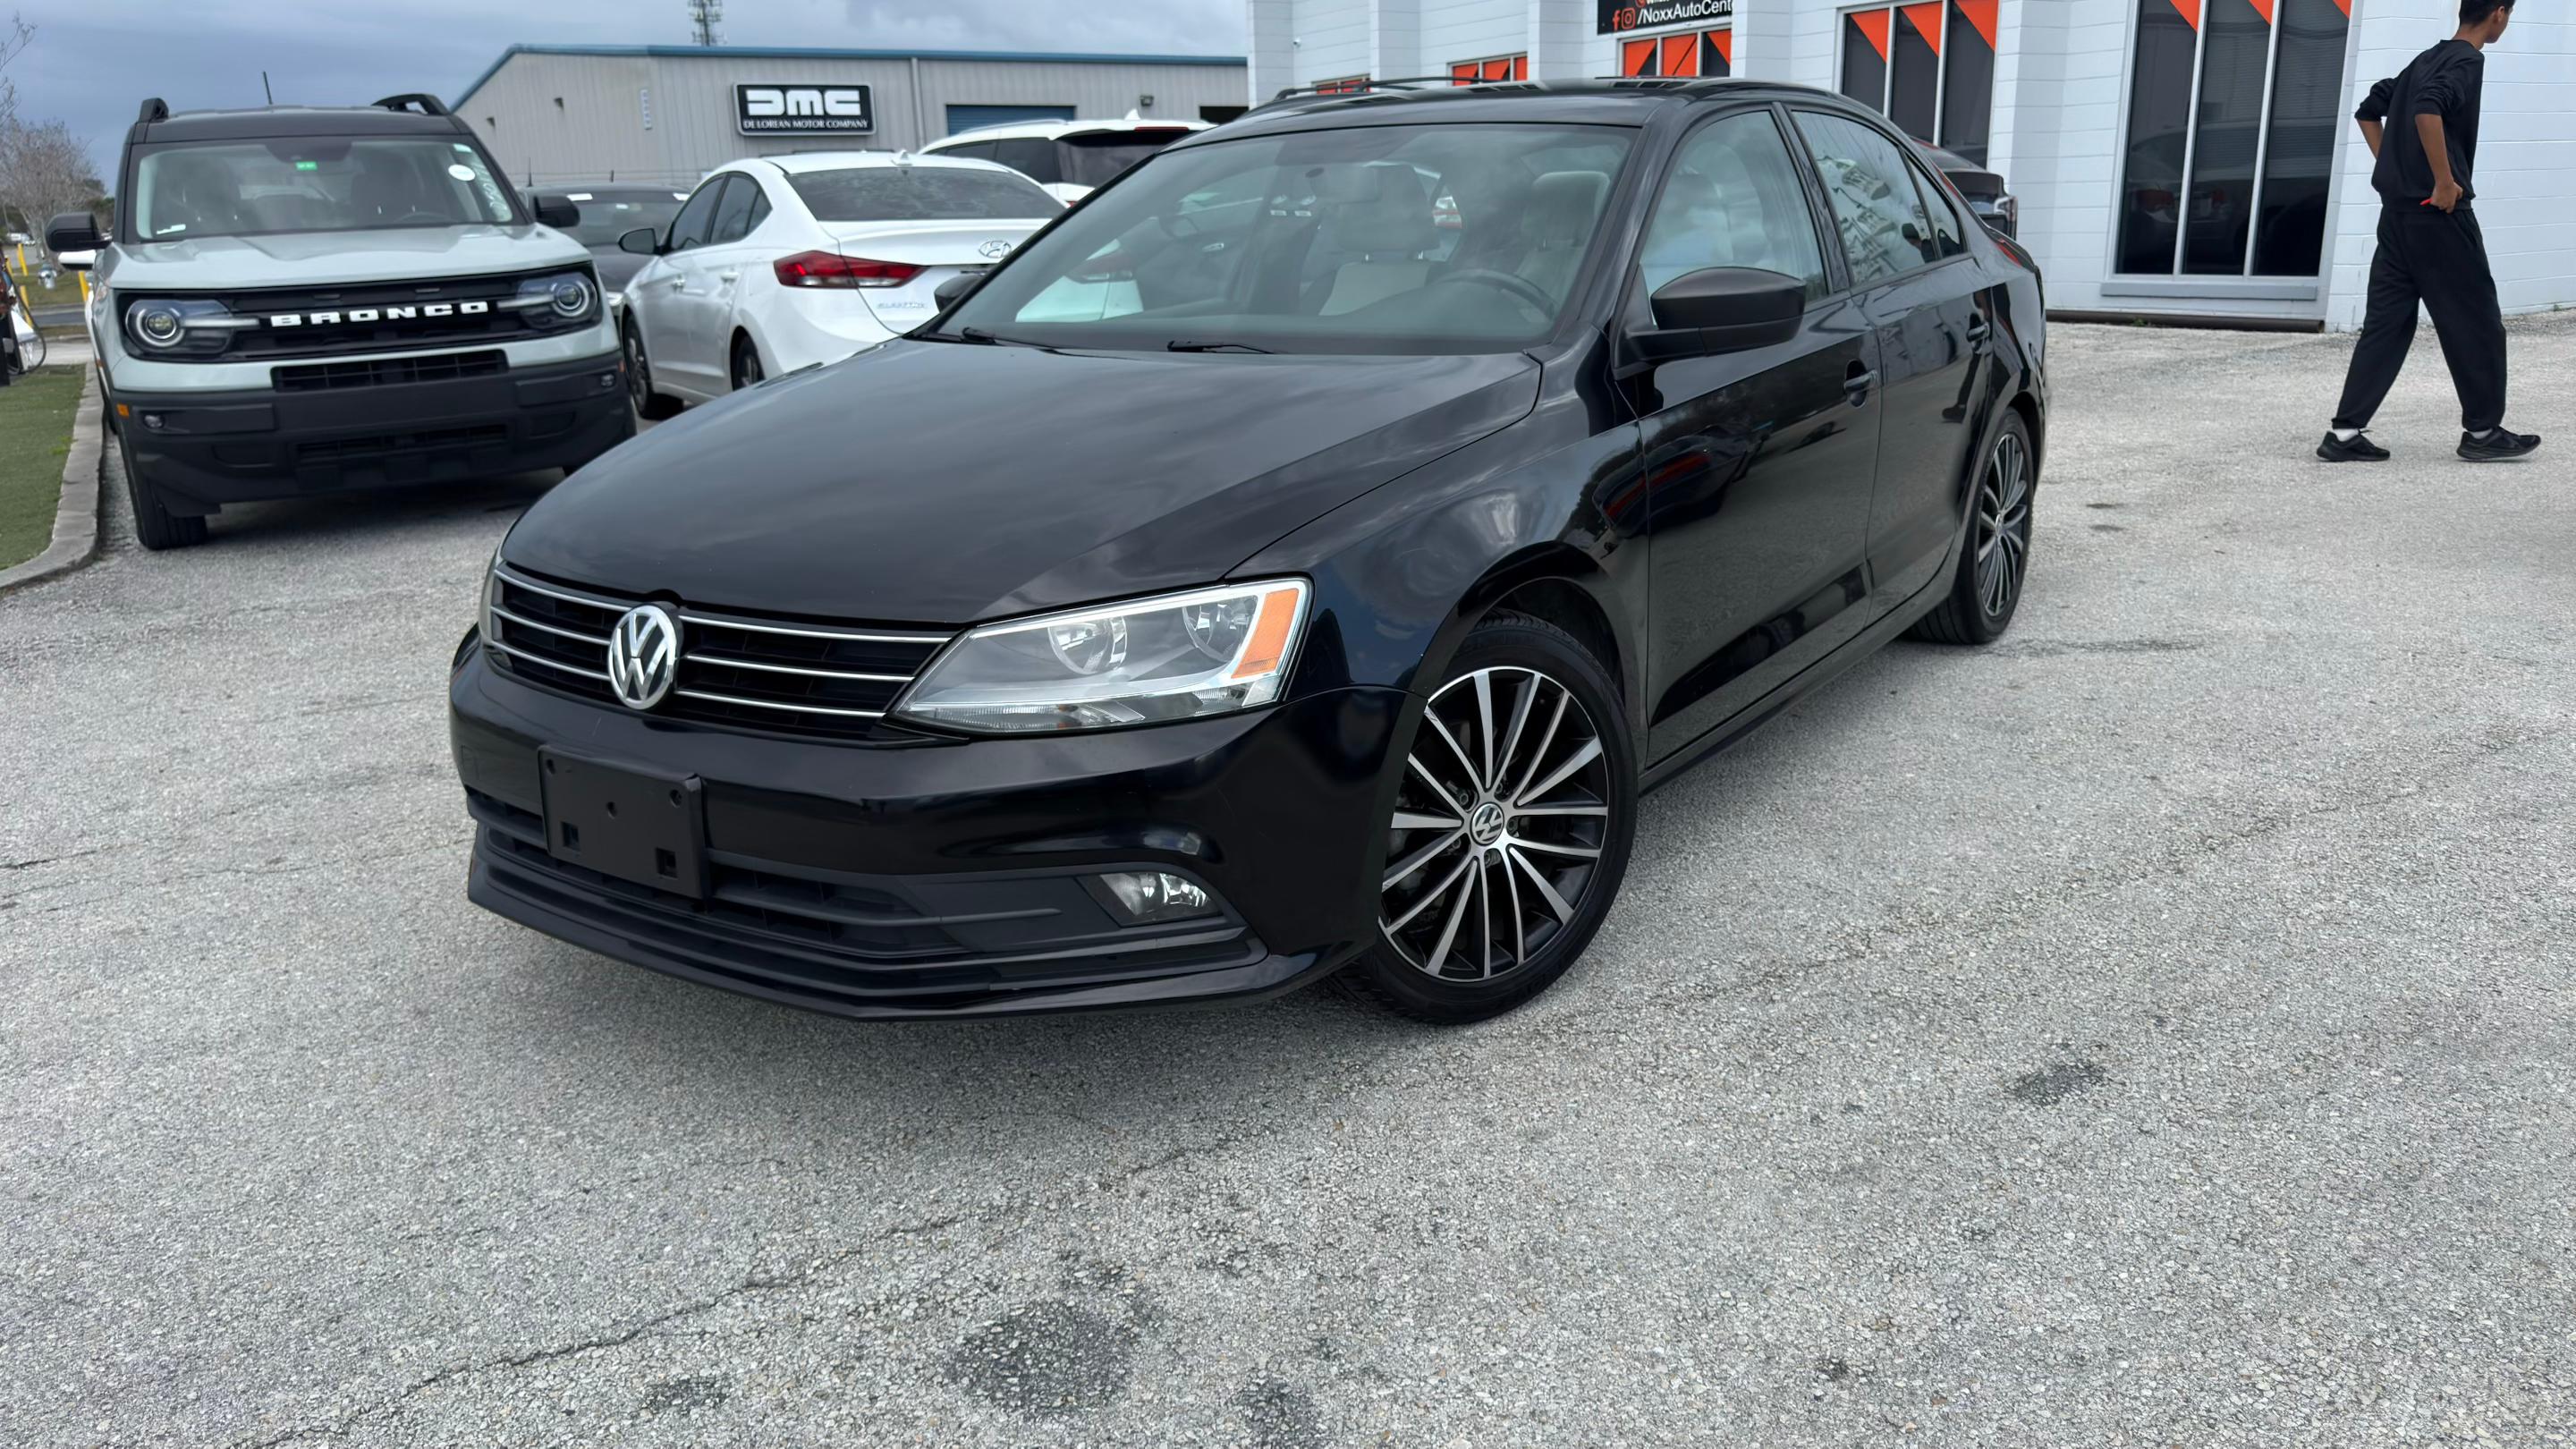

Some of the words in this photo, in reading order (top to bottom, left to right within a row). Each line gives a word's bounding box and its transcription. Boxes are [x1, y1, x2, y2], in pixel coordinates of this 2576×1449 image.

[1637, 0, 1732, 25] /NoxxAutoCent
[743, 119, 755, 129] DE
[758, 119, 791, 129] LOREAN
[792, 119, 825, 129] MOTOR
[826, 119, 869, 129] COMPANY
[271, 301, 488, 327] BRONCO
